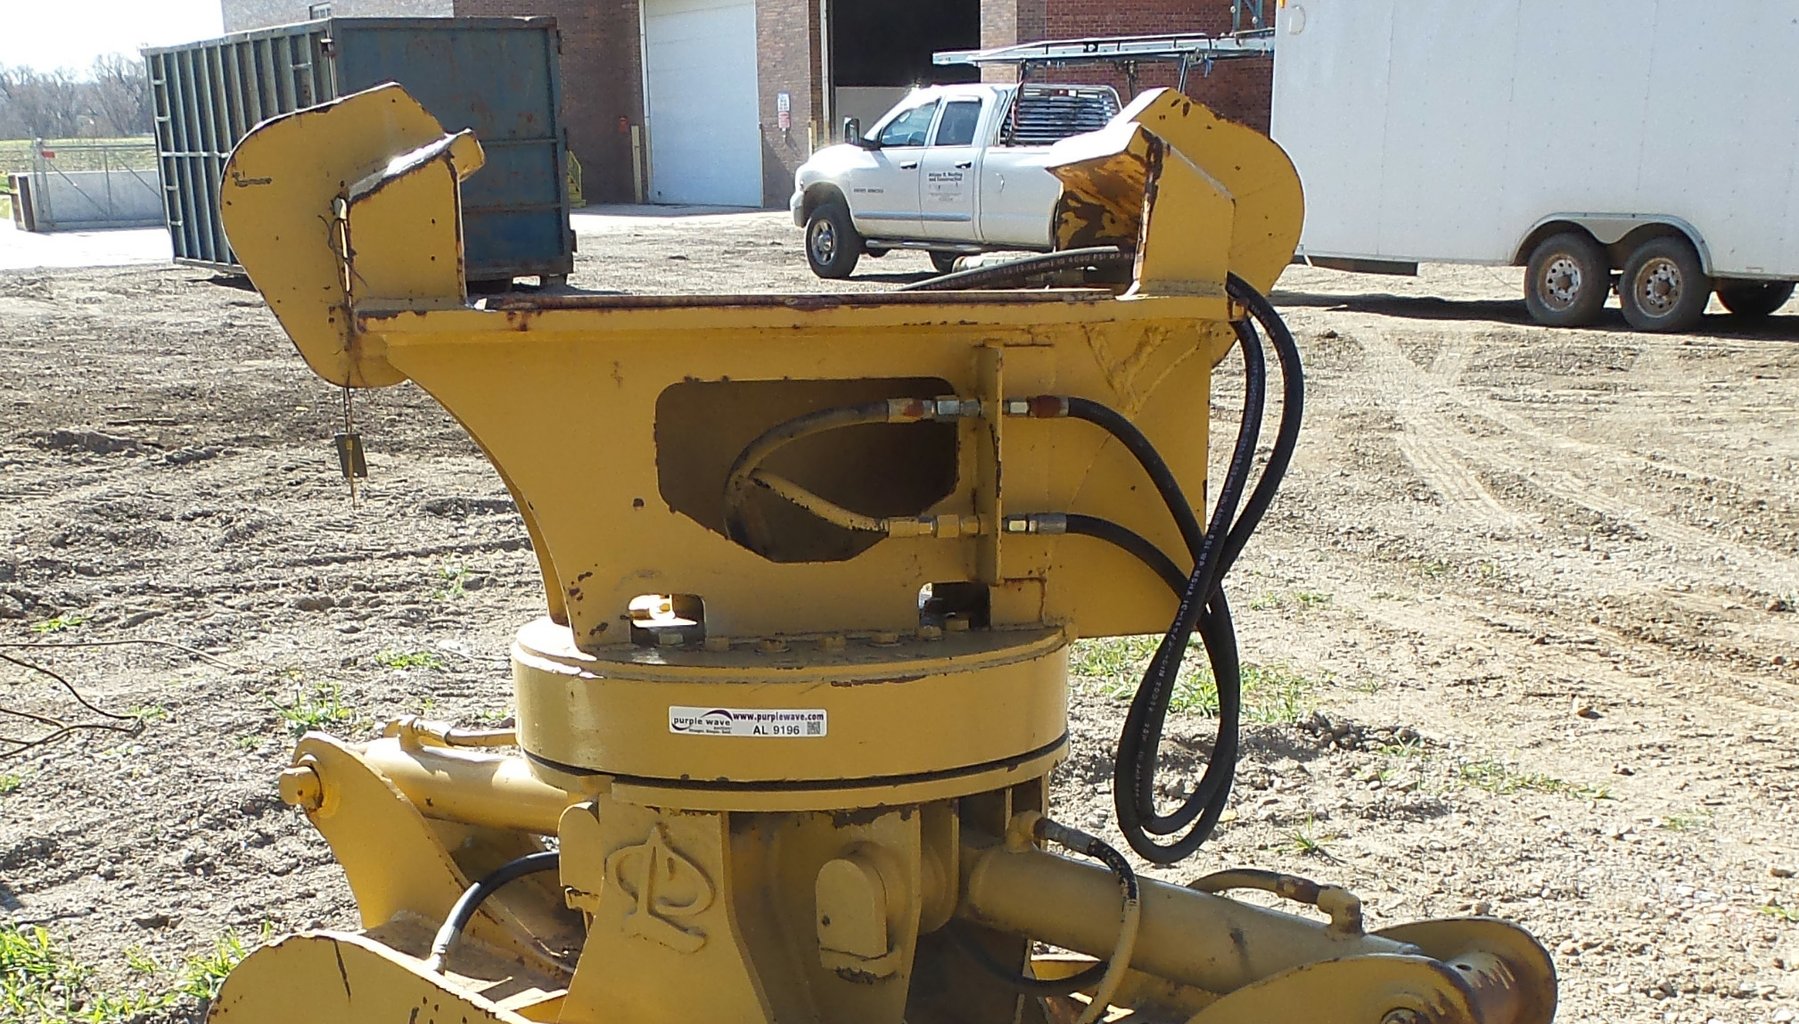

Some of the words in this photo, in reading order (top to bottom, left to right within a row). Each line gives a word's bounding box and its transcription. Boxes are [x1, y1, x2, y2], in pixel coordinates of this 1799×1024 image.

[674, 717, 703, 726] purple
[733, 712, 824, 723] www.purplewave.com
[753, 726, 768, 735] AL
[773, 725, 800, 735] 9196
